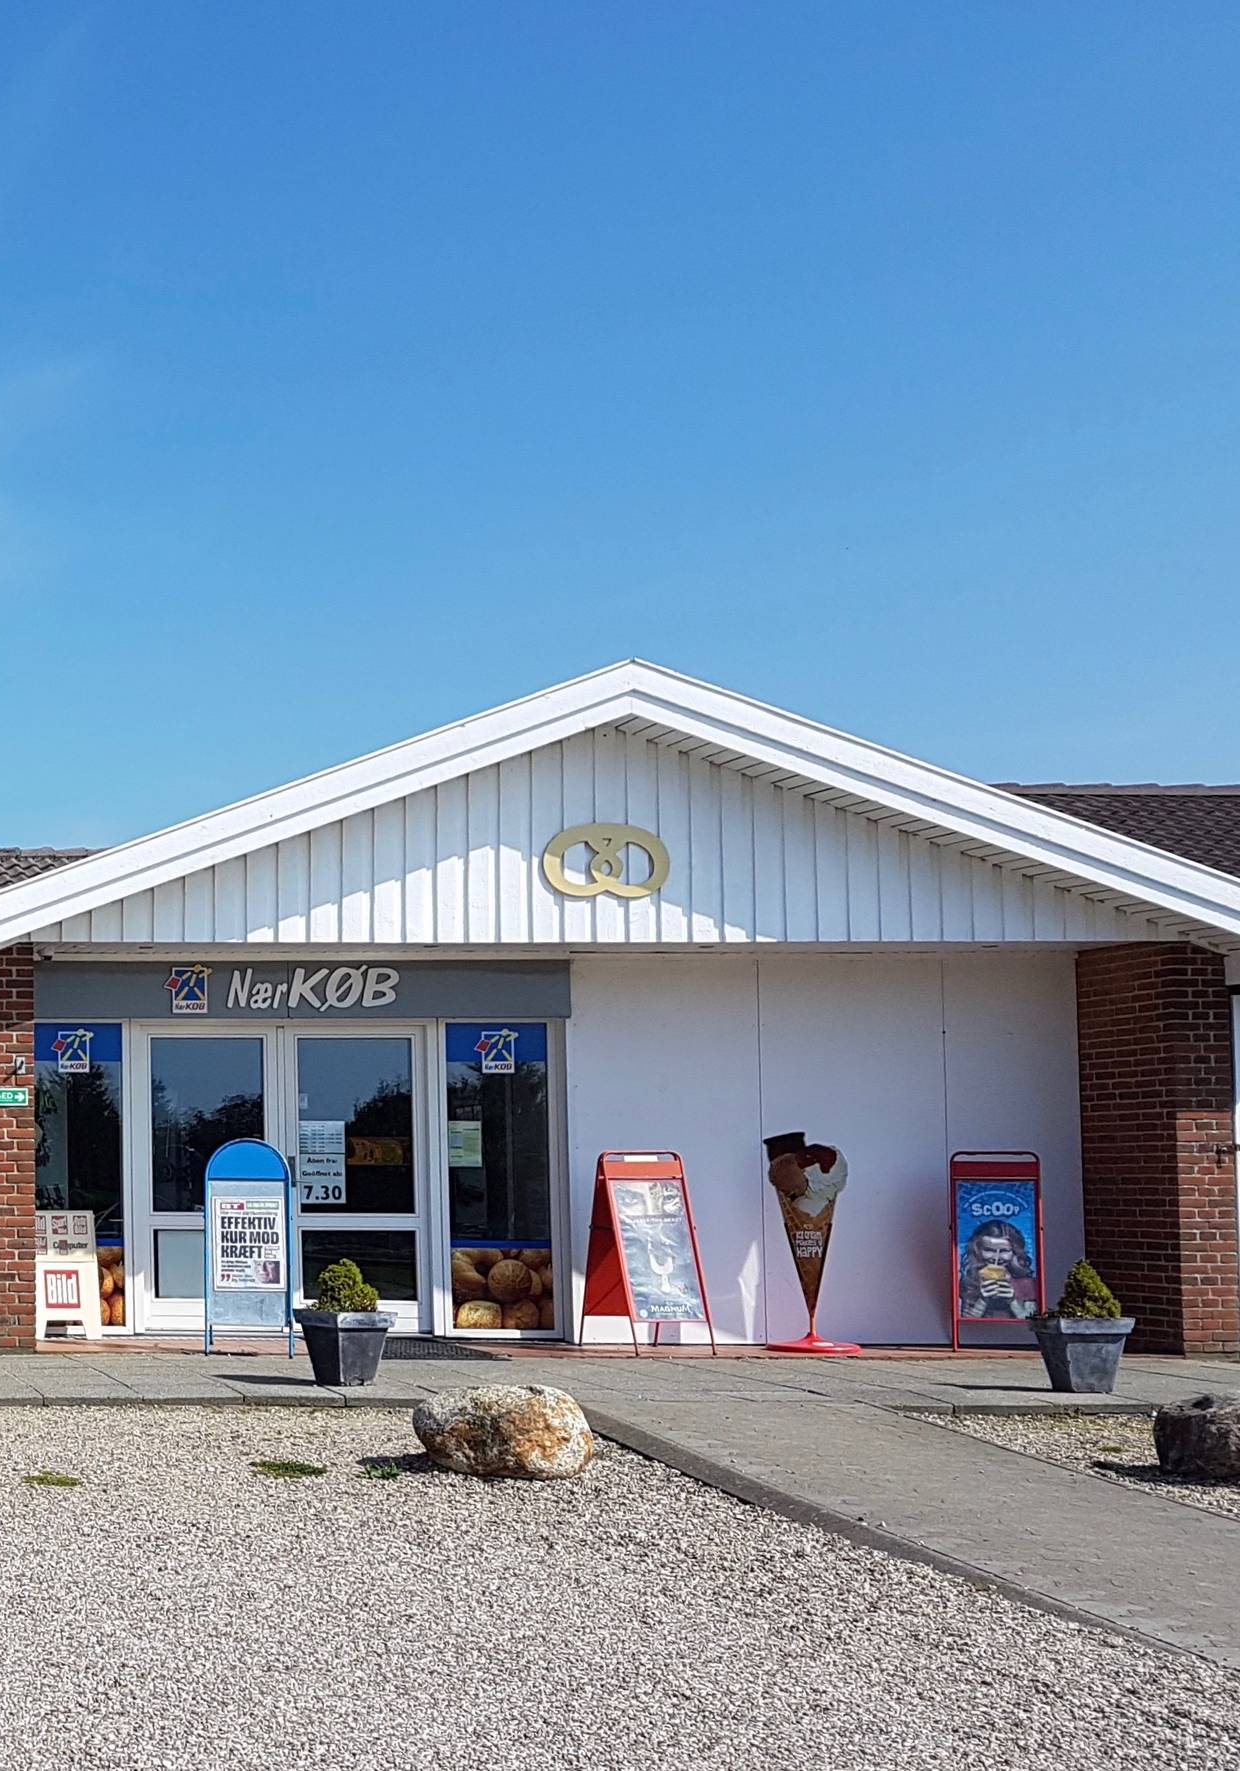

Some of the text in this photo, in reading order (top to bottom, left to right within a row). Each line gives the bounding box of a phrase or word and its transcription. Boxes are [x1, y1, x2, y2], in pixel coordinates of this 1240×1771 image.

[226, 965, 400, 1012] NærKØB
[303, 1185, 343, 1201] 7.30
[221, 1216, 276, 1230] EFFEKTIV
[221, 1231, 280, 1245] KUR MOD
[221, 1245, 263, 1259] KRÆFT
[46, 1273, 79, 1304] Bild
